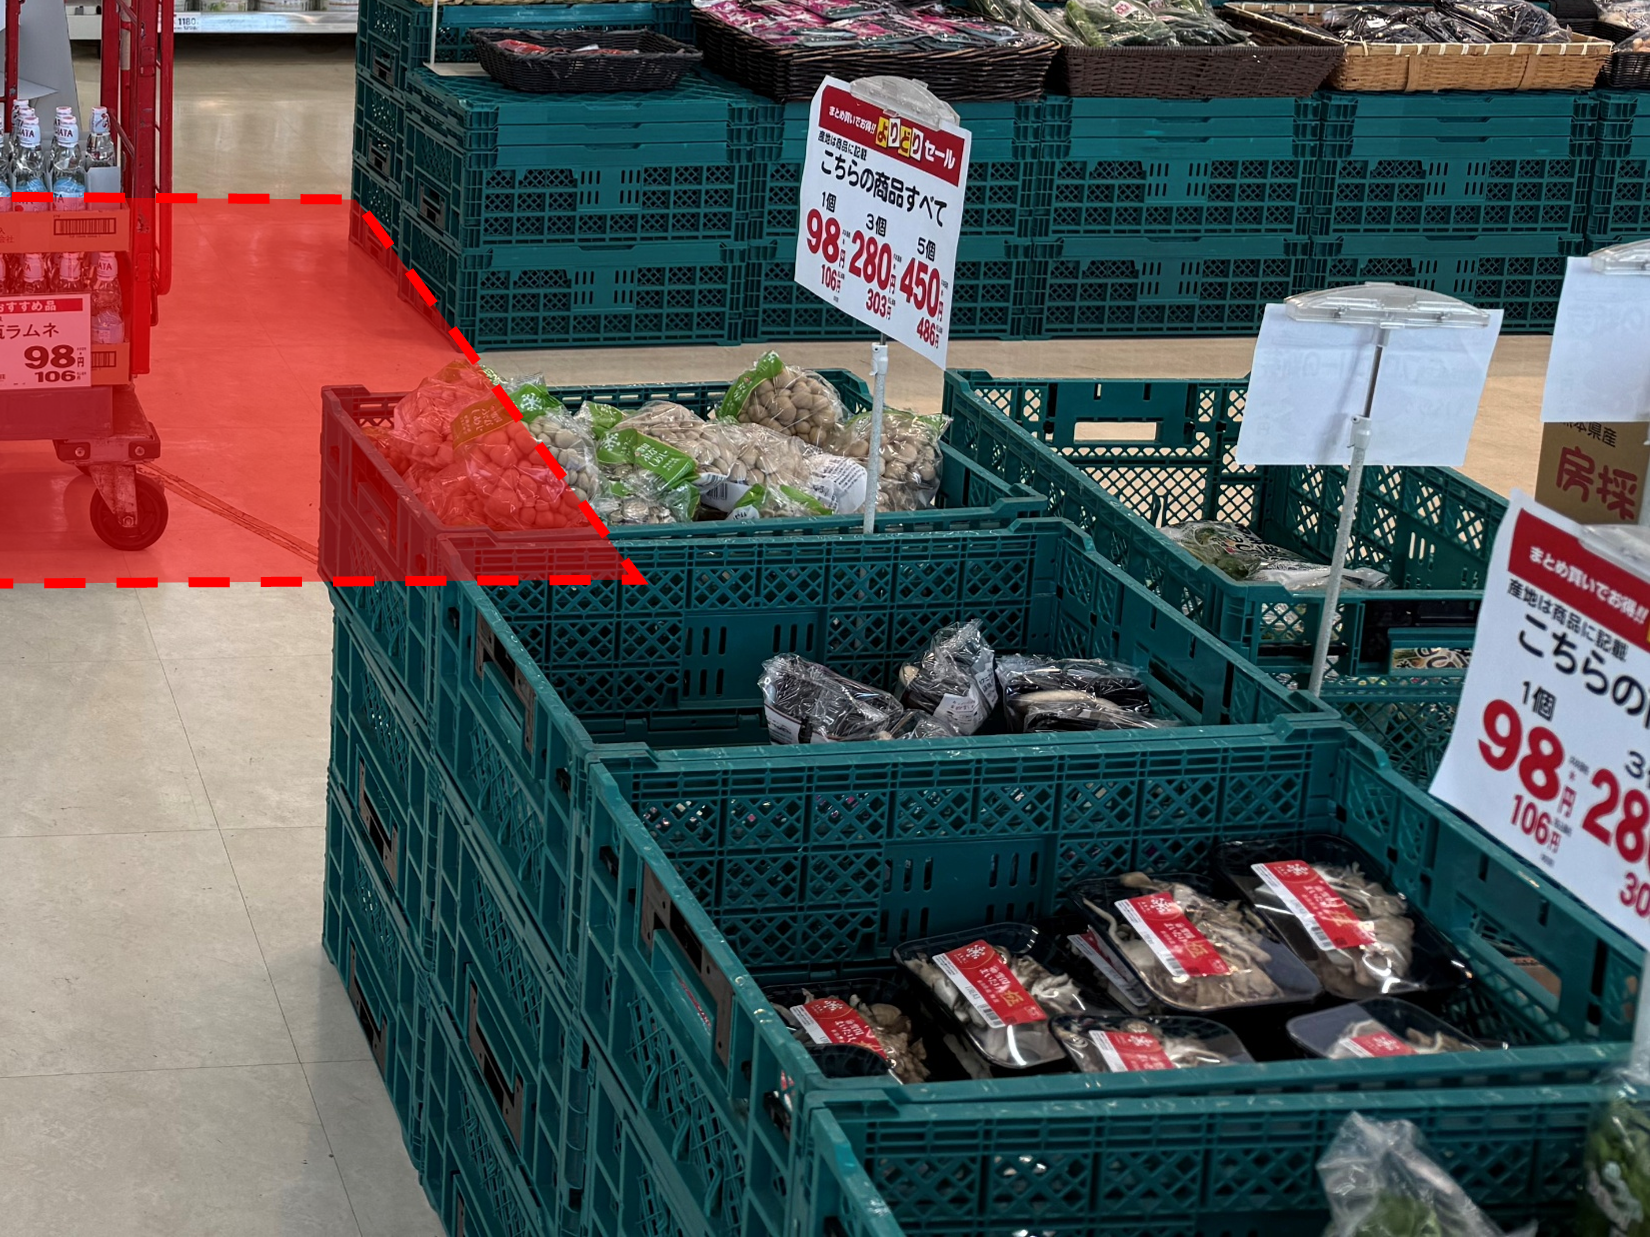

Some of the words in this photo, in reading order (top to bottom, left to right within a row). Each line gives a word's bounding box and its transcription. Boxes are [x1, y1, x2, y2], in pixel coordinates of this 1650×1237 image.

[876, 117, 924, 161] よりどり
[924, 140, 956, 170] セール
[821, 149, 948, 228] こちらの商品すべて
[821, 191, 837, 213] 1個
[806, 208, 841, 264] 98
[865, 213, 887, 237] 3個
[917, 237, 936, 262] 5個
[821, 263, 837, 292] 106
[848, 229, 893, 291] 280
[865, 289, 887, 319] 303
[899, 256, 940, 319] 450
[24, 344, 76, 369] 98
[916, 317, 936, 348] 486
[34, 370, 76, 383] 106
[1507, 579, 1630, 663] 産地は商品に記載
[1518, 614, 1650, 730] こちらの
[1521, 680, 1557, 722] 1個
[1478, 698, 1565, 803] 98
[1510, 794, 1551, 846] 106
[1582, 768, 1650, 866] 28
[1619, 873, 1650, 919] 30
